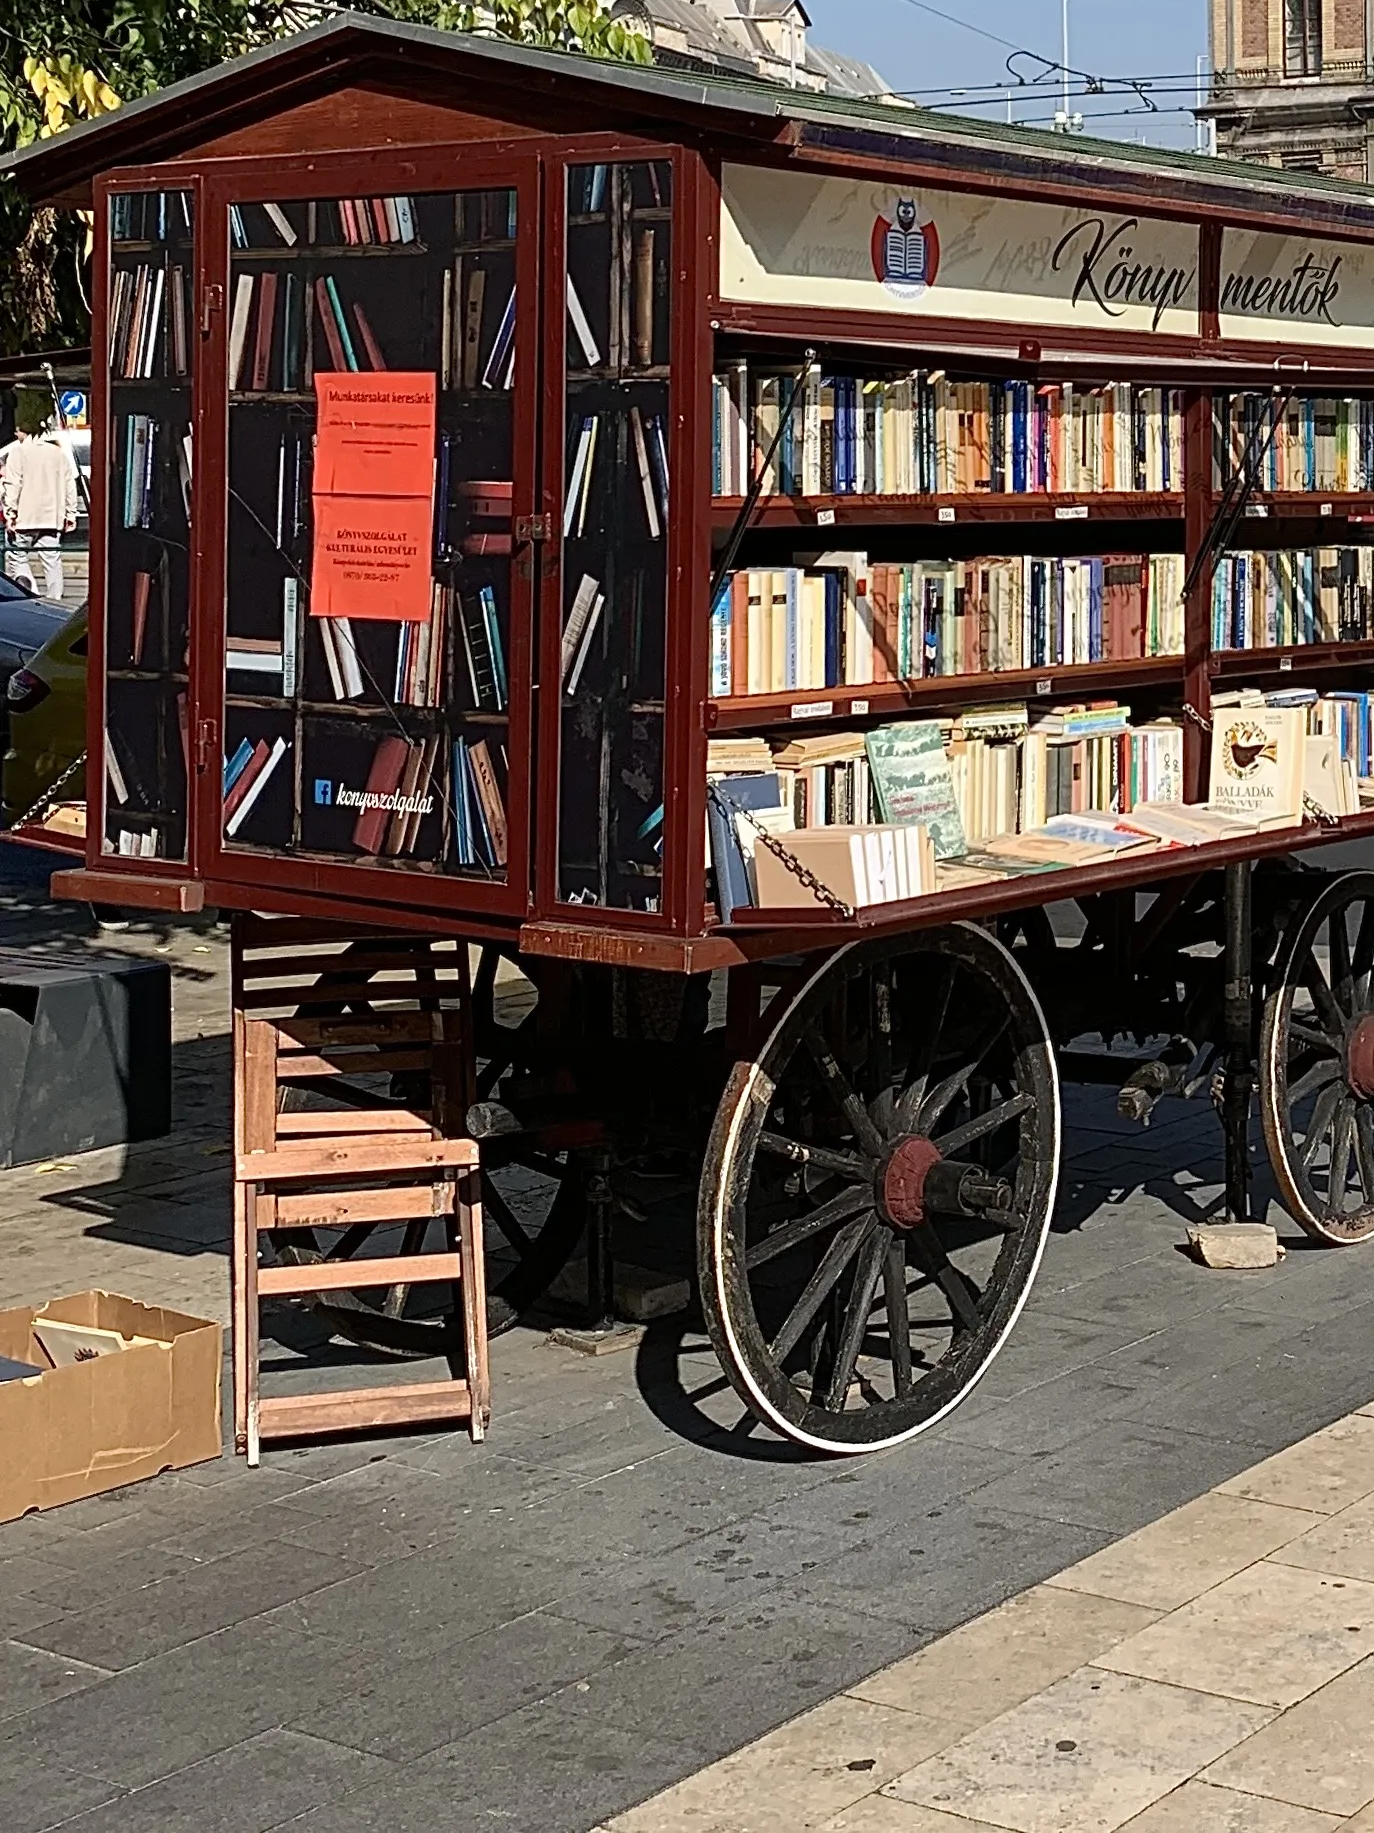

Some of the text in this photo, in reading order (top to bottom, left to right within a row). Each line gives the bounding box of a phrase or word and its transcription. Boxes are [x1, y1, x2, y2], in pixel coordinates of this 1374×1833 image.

[1052, 218, 1343, 332] Könyv mentők
[336, 783, 434, 820] konyvszolgalat
[1216, 784, 1275, 798] BALLADÁK
